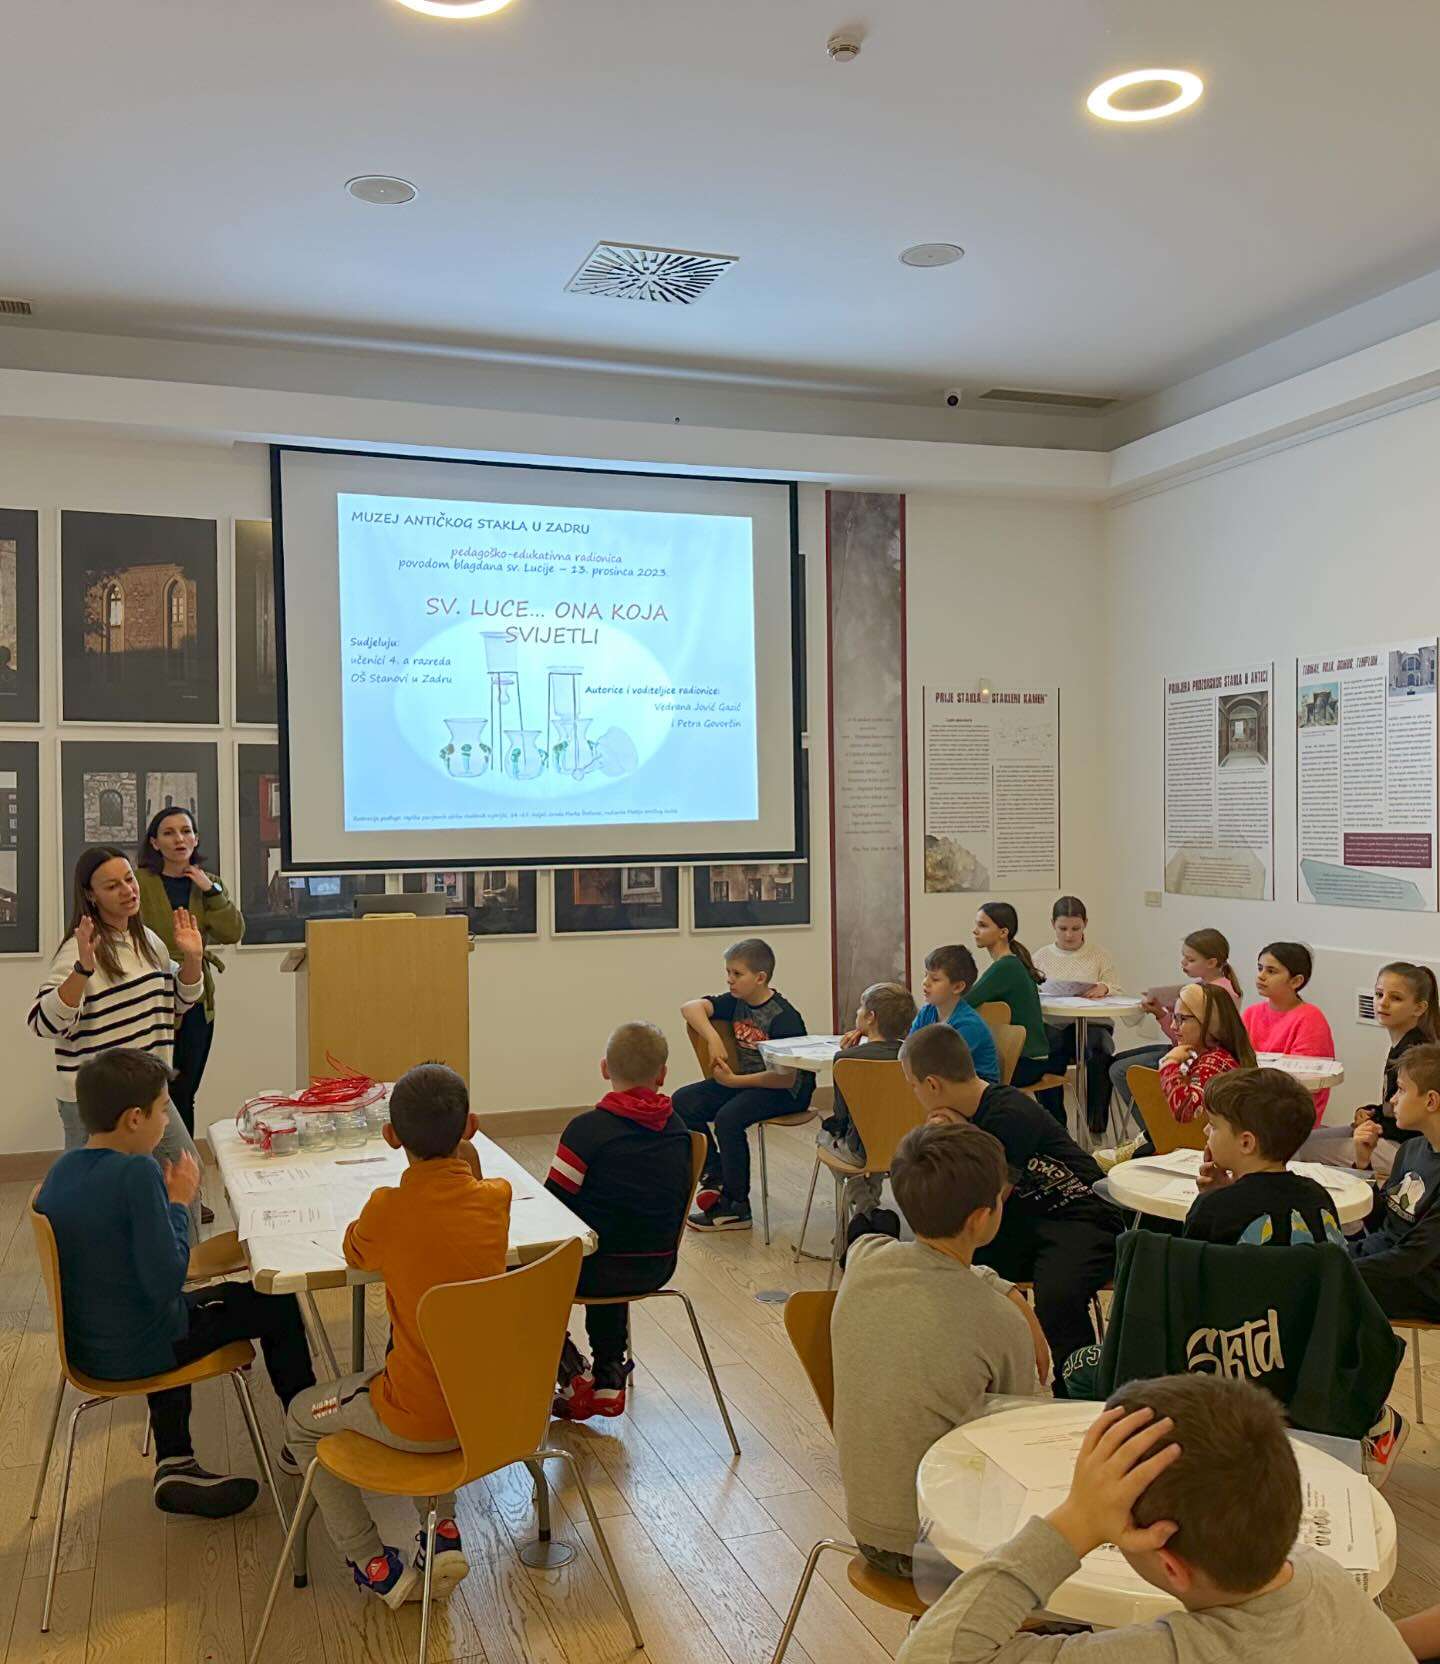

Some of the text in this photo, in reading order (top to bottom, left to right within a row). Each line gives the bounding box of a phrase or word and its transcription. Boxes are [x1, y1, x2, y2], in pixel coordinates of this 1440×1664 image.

[351, 511, 590, 534] MUZEJ ANTIČKOG STAKLA U ZADRU
[450, 546, 622, 563] pedagoško-edukativna radionica
[398, 558, 450, 570] povodom
[454, 558, 503, 573] blagdana
[507, 563, 520, 572] sv.
[524, 562, 554, 575] Lucije
[592, 566, 634, 578] prosinca
[426, 597, 461, 616] SV.
[555, 601, 603, 619] ONA
[611, 603, 669, 622] KOJA
[505, 626, 599, 645] SVIJETLI
[350, 654, 386, 665] učenici
[403, 657, 410, 665] a
[413, 656, 452, 666] razreda
[351, 671, 453, 684] OŠ Stanovi u Zadru
[584, 685, 624, 695] Autorice
[632, 685, 676, 697] voditeljice
[935, 692, 954, 704] PRIJE
[654, 703, 692, 712] Vedrana
[677, 719, 701, 729] Petra
